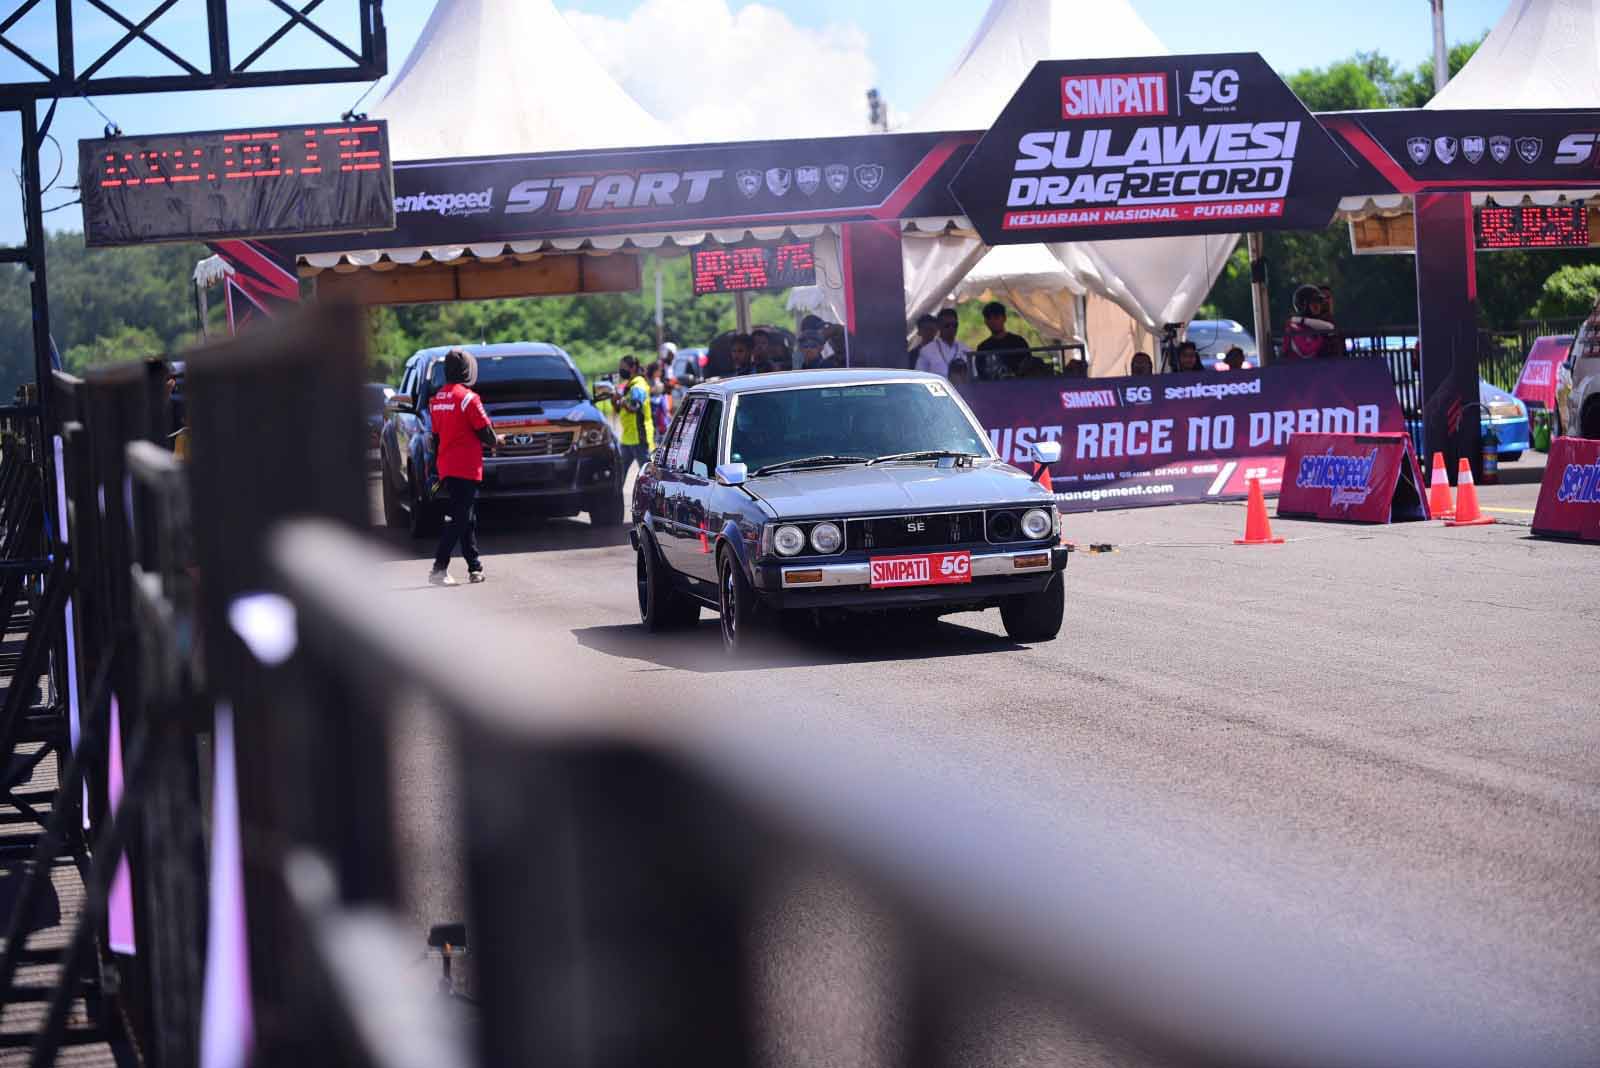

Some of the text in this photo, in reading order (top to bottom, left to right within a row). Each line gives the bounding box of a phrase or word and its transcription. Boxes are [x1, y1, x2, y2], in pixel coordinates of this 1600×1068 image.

[1065, 69, 1240, 116] SIMPATI 5G
[1015, 121, 1301, 171] SULAWESI
[1553, 133, 1600, 165] S
[393, 187, 494, 216] enicspeed
[504, 169, 724, 215] START
[1009, 202, 1281, 226] KEJUARAAN NASIONAL PUTARAN 2
[1062, 386, 1153, 409] SIMPATI 5G
[1165, 378, 1261, 400] senicspeed
[984, 404, 1380, 464] UST RACE NO DRAMA
[907, 522, 926, 532] SE
[872, 554, 970, 582] SIMPATI 5G
